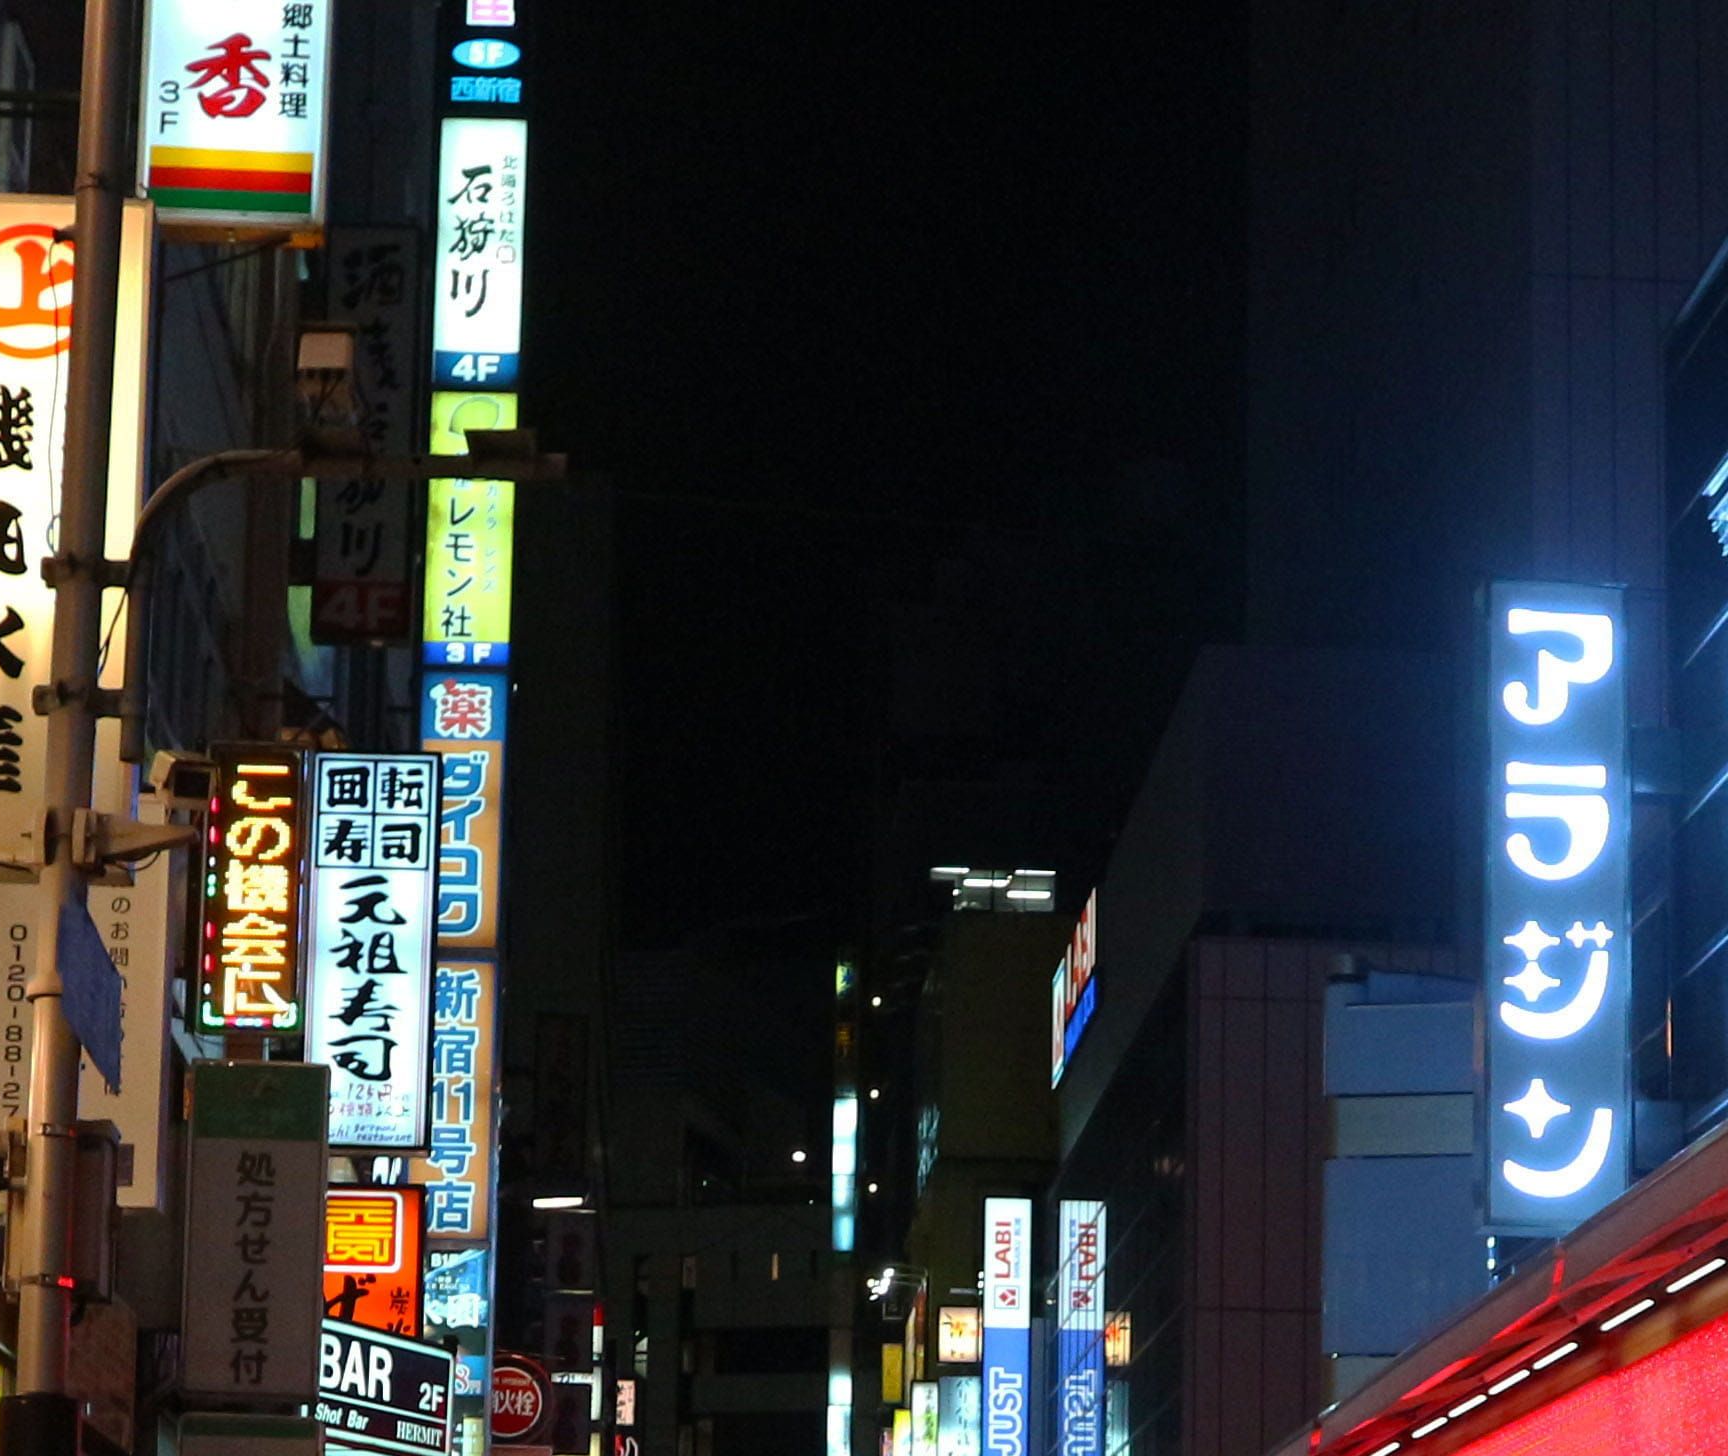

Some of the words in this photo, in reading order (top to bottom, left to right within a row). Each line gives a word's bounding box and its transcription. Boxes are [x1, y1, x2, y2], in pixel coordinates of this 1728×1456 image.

[186, 32, 271, 119] 香
[281, 2, 313, 119] 郷土料理
[447, 165, 497, 318] 石狩川
[452, 354, 501, 382] 4F
[441, 497, 474, 637] レモン社
[446, 643, 493, 664] 3F
[432, 679, 492, 736] 薬
[325, 819, 422, 864] 寿司
[440, 752, 489, 937] ダイコク
[1500, 607, 1614, 1198] アラジン
[328, 874, 409, 1081] 元祖寿司
[229, 1151, 277, 1386] 処方せん受付
[994, 1221, 1012, 1279] LABI
[321, 1332, 394, 1403] BAR
[418, 1383, 445, 1413] 2F
[314, 1402, 343, 1425] Shot
[346, 1408, 370, 1432] Bar
[396, 1420, 445, 1448] HERMIT
